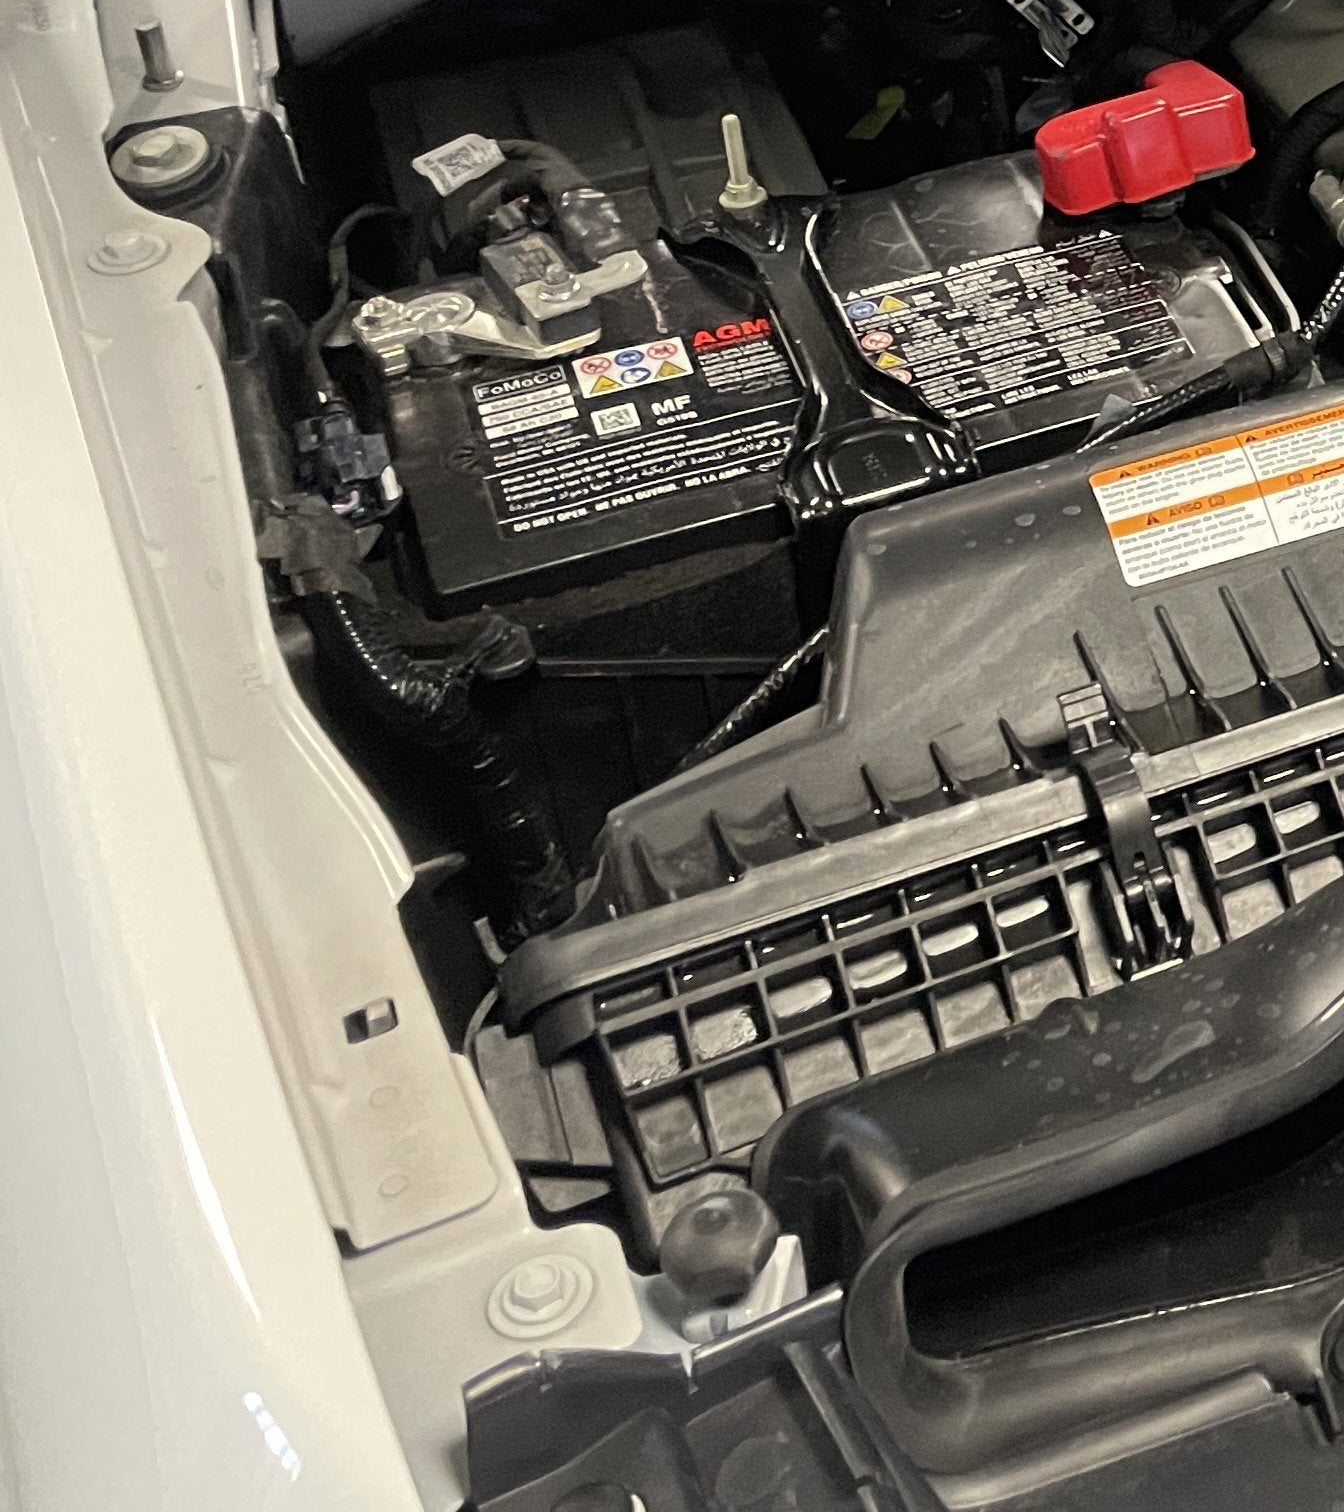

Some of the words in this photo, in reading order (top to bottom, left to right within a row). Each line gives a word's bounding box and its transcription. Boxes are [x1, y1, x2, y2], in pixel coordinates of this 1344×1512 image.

[692, 318, 771, 347] AGM
[477, 370, 562, 399] FoMoCo
[651, 395, 691, 416] MF
[1168, 500, 1203, 519] AVISO
